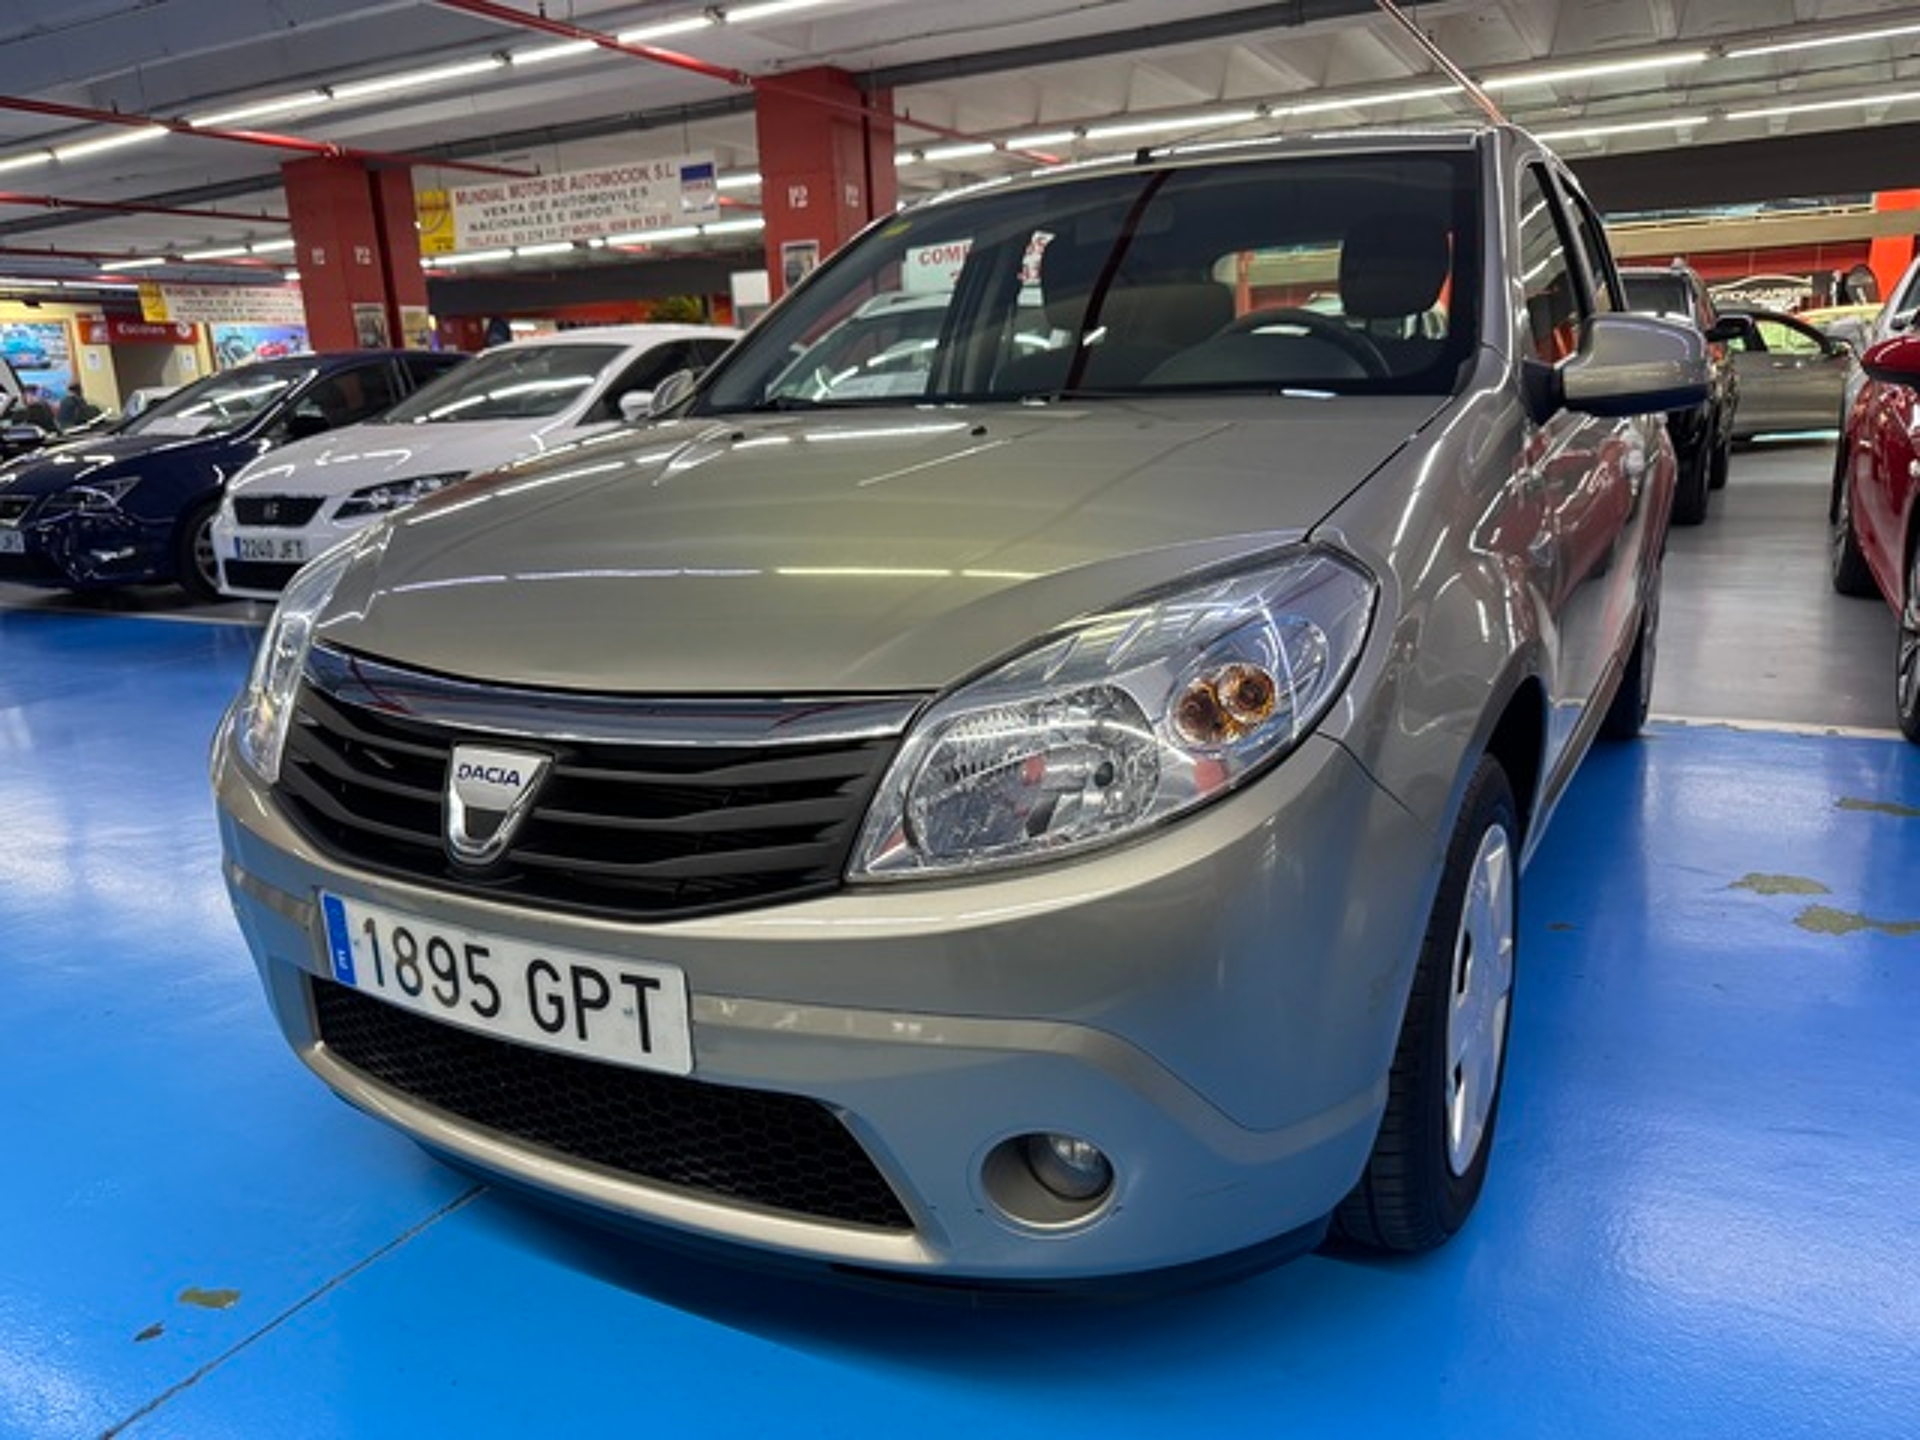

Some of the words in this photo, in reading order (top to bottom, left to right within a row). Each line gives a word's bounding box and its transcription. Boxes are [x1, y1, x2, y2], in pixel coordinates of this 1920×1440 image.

[455, 188, 507, 206] MUNDIAL
[509, 180, 548, 199] MOTOR
[551, 177, 566, 194] DE
[482, 204, 525, 218] VENTA
[530, 199, 546, 213] DE
[551, 187, 649, 210] AUTOMOVILES
[469, 211, 553, 232] NACIONALES
[456, 763, 521, 787] DACIA
[362, 917, 502, 1018] 1895
[525, 958, 662, 1054] GPT
